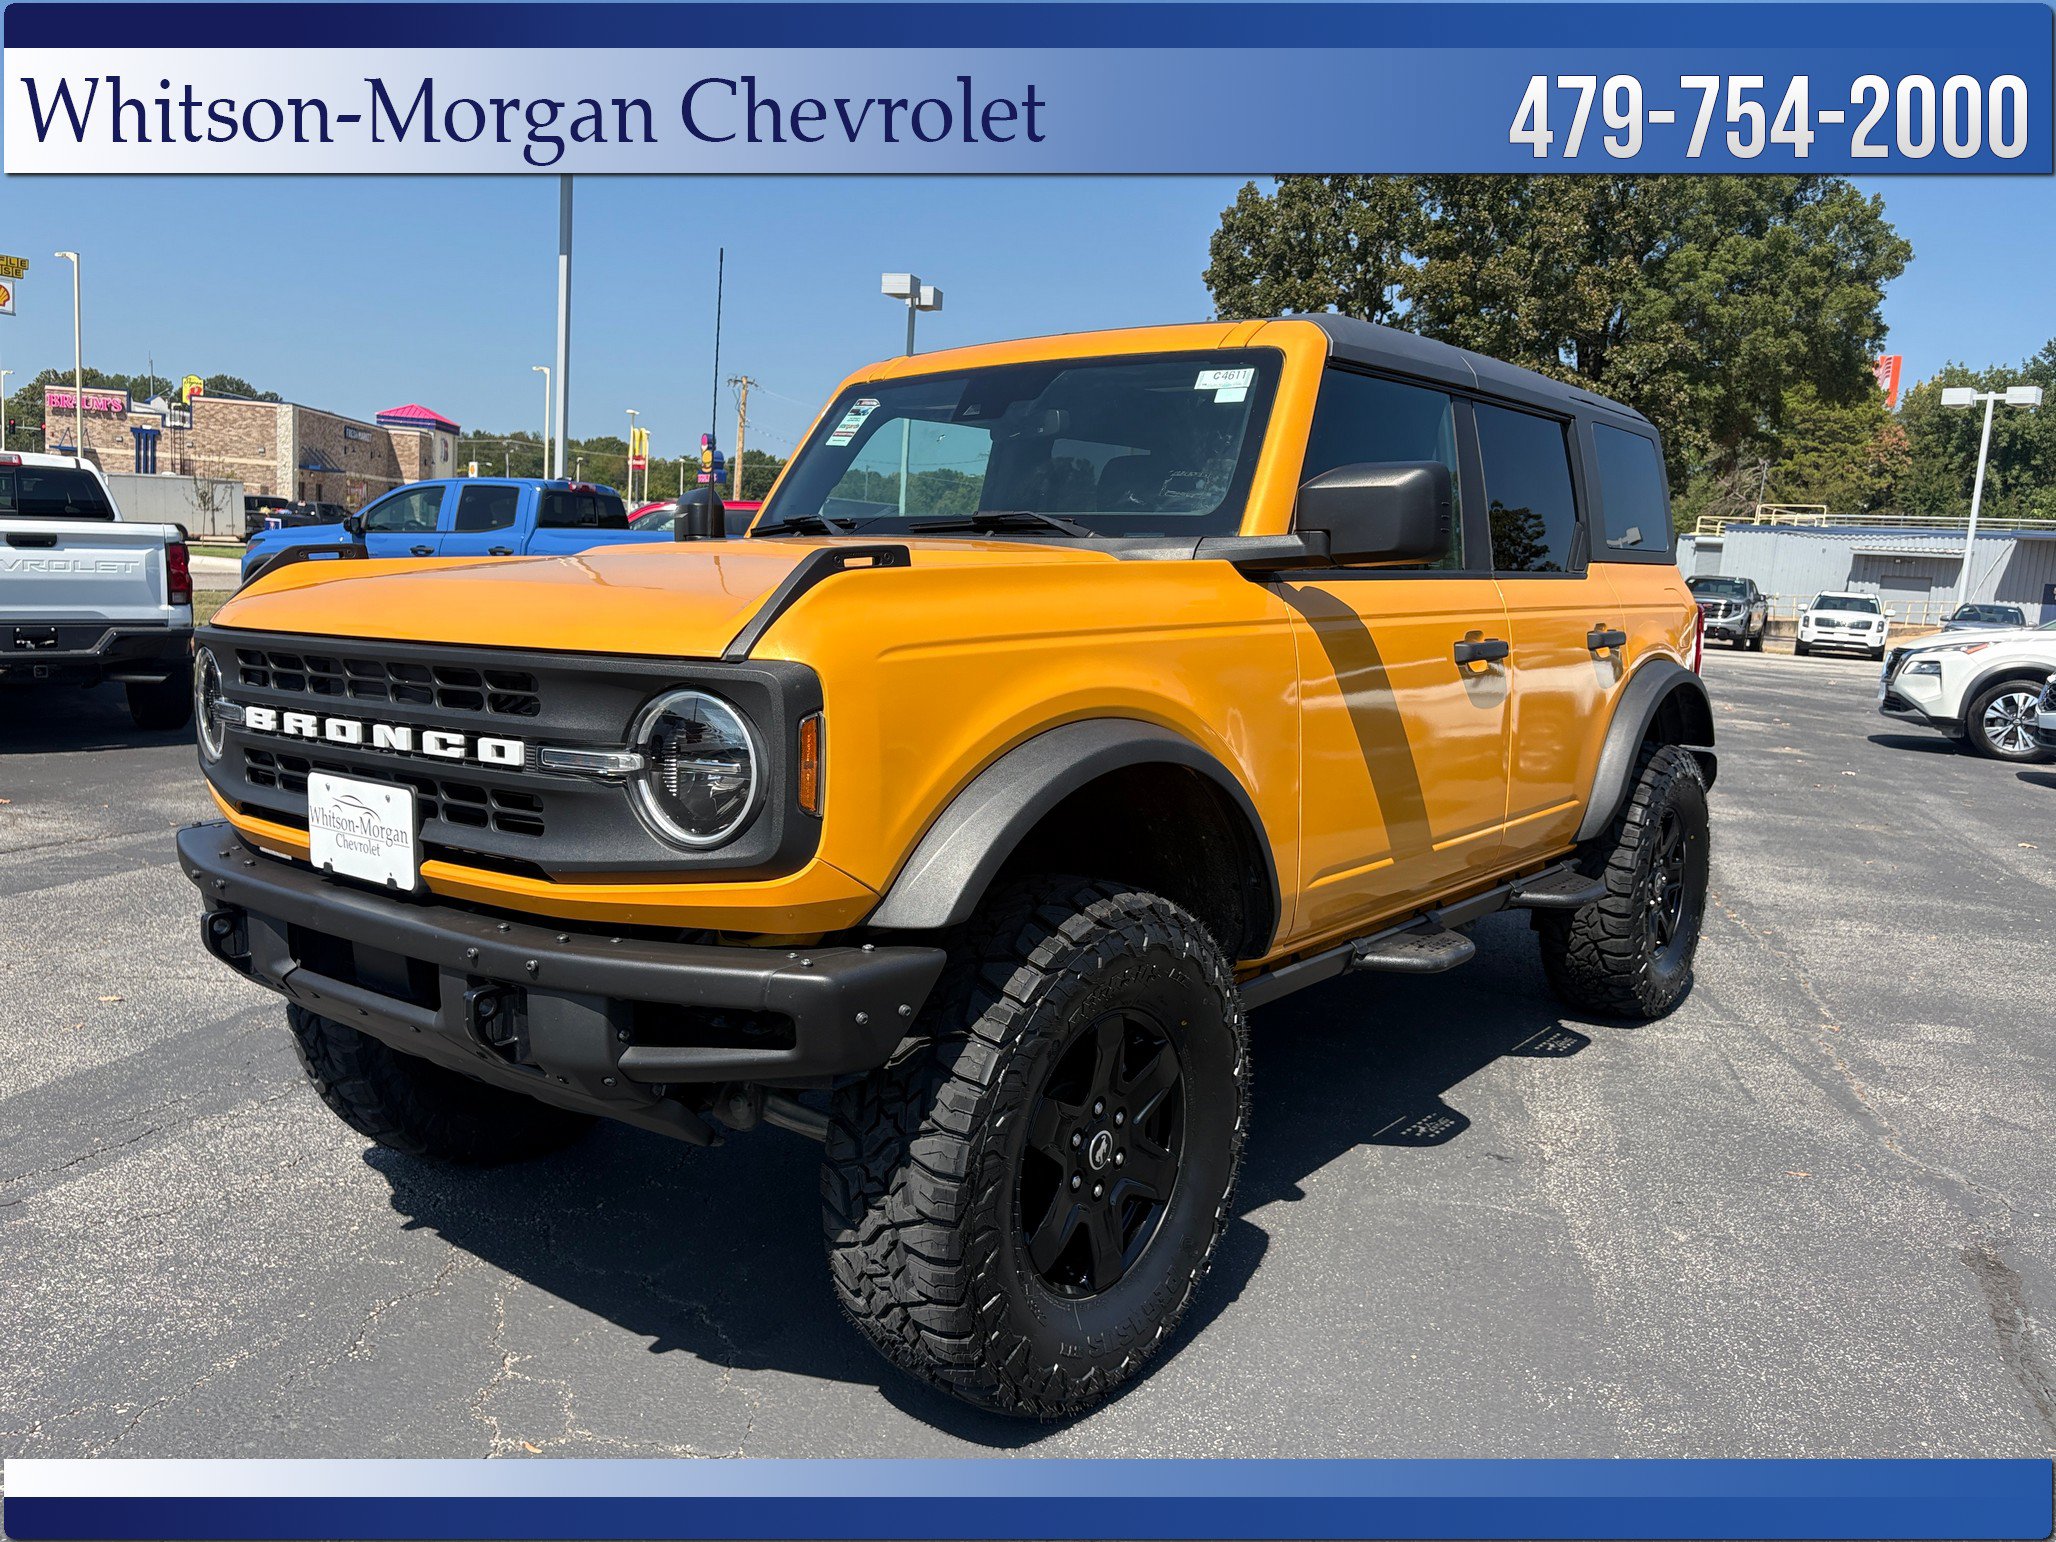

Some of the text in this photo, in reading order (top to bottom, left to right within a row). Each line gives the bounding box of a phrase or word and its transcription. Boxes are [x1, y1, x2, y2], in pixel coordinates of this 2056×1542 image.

[1213, 371, 1247, 380] C4611
[46, 393, 123, 412] BRUM'S
[245, 706, 526, 767] BRONCO
[310, 805, 408, 847] Whitson-Morgan
[335, 833, 380, 856] Chevrolet
